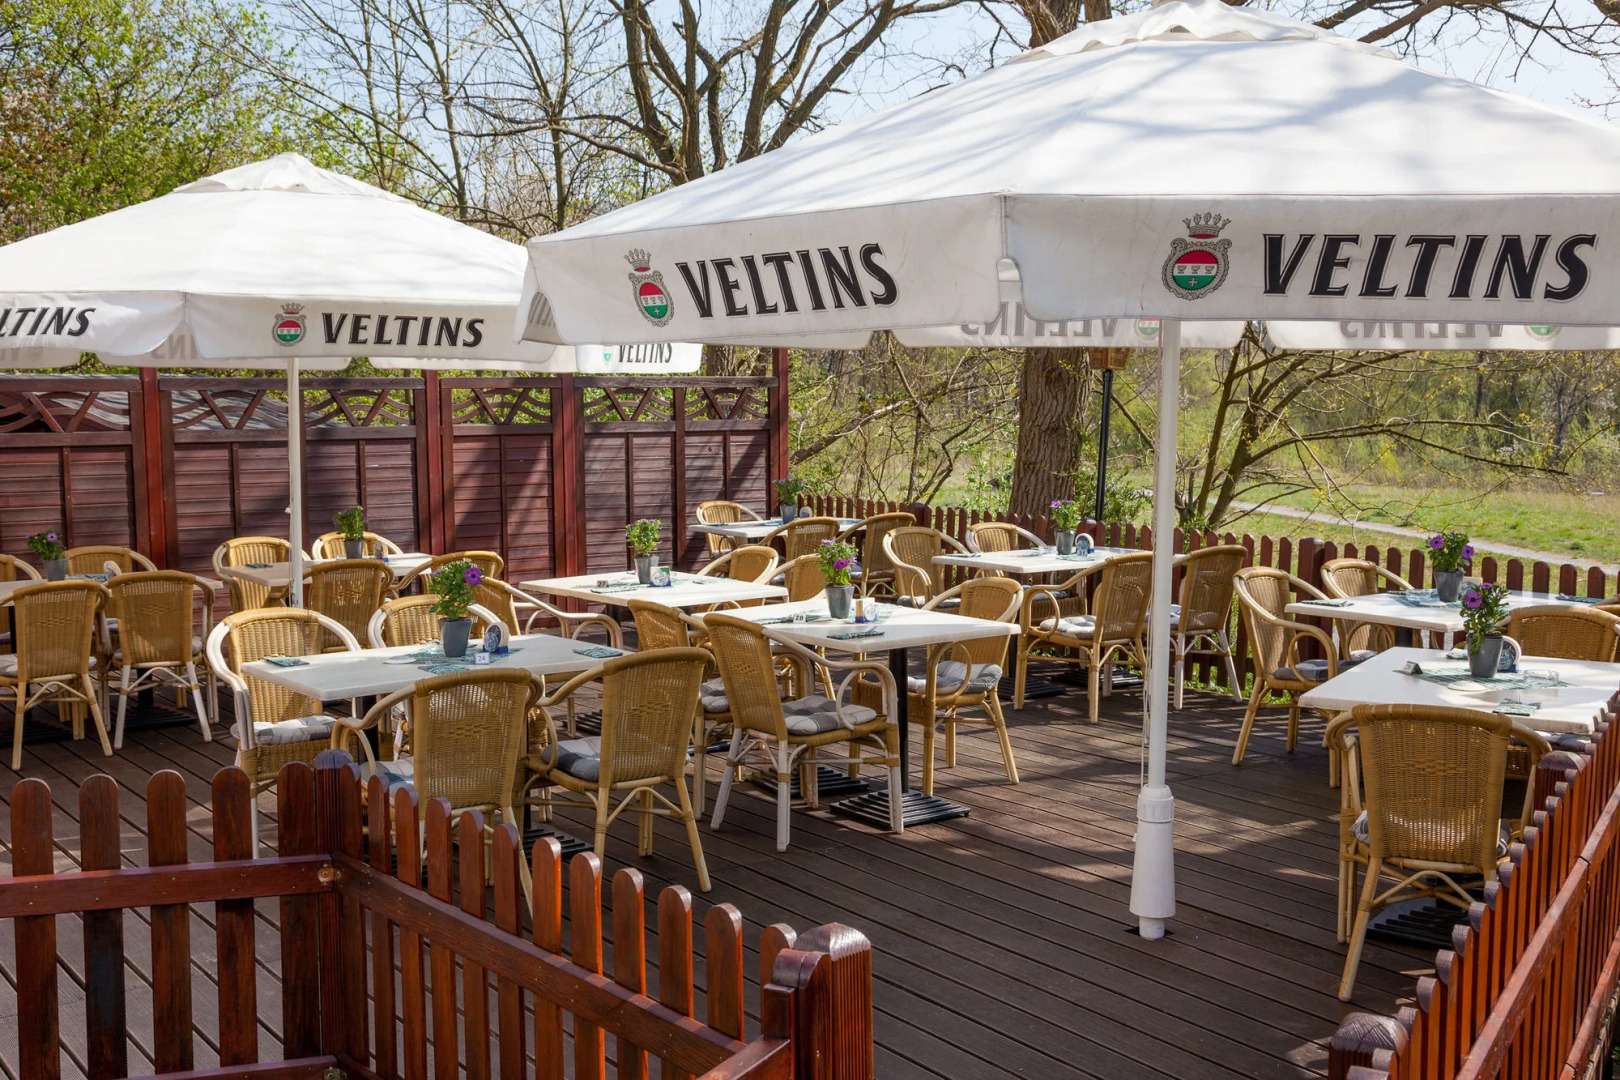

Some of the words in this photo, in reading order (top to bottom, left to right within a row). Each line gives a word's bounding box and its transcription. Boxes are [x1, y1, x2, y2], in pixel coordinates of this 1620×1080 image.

[675, 243, 899, 318] VELTINS
[1262, 233, 1597, 301] VELTINS
[321, 312, 484, 347] VELTINS
[597, 580, 606, 588] 27
